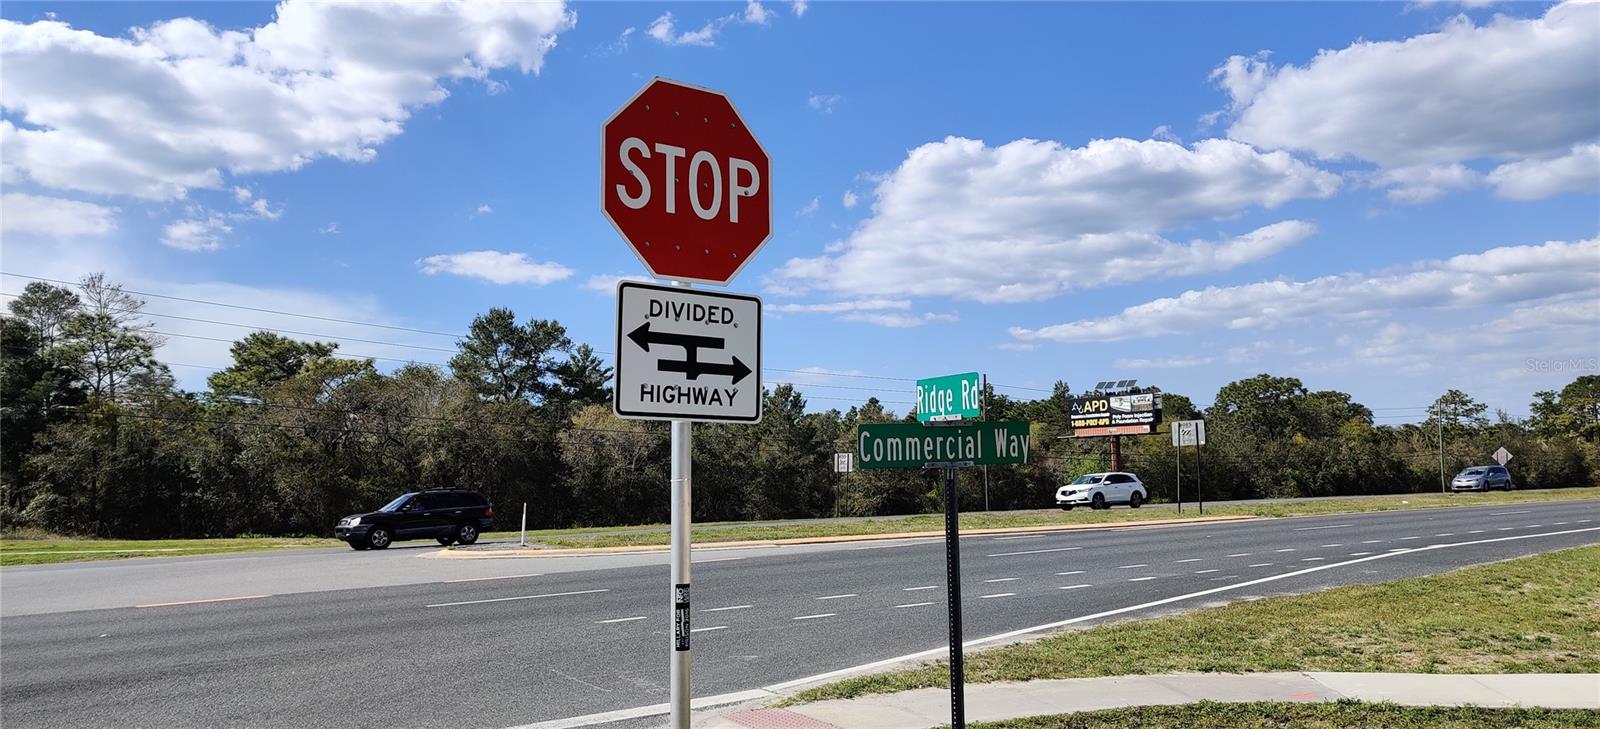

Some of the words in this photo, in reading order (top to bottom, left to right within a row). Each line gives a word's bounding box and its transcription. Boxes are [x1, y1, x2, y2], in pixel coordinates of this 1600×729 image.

[616, 136, 760, 224] STOP
[649, 299, 734, 325] DIVIDED
[640, 383, 739, 407] HIGHWAY
[917, 385, 953, 415] Ridge
[962, 379, 979, 410] Rd
[1084, 400, 1108, 412] APD
[859, 429, 982, 462] Commercial
[994, 428, 1030, 464] Way
